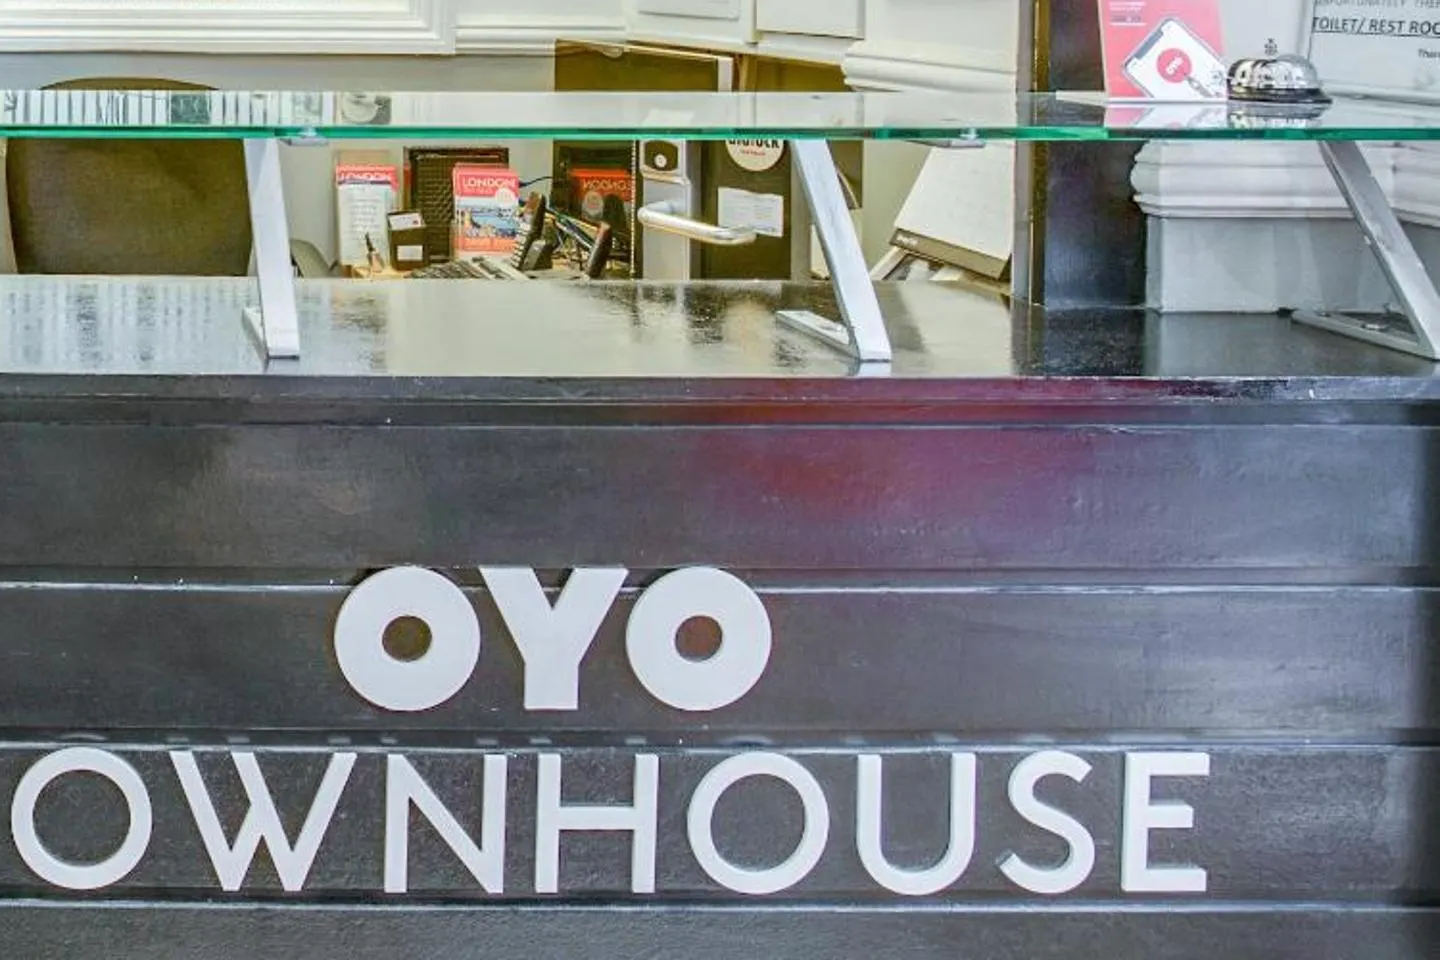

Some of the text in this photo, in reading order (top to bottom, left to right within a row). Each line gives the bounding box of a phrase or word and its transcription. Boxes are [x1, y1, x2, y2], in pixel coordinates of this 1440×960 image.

[1369, 19, 1406, 34] REST
[462, 175, 518, 189] LONDON
[334, 564, 772, 713] OYO
